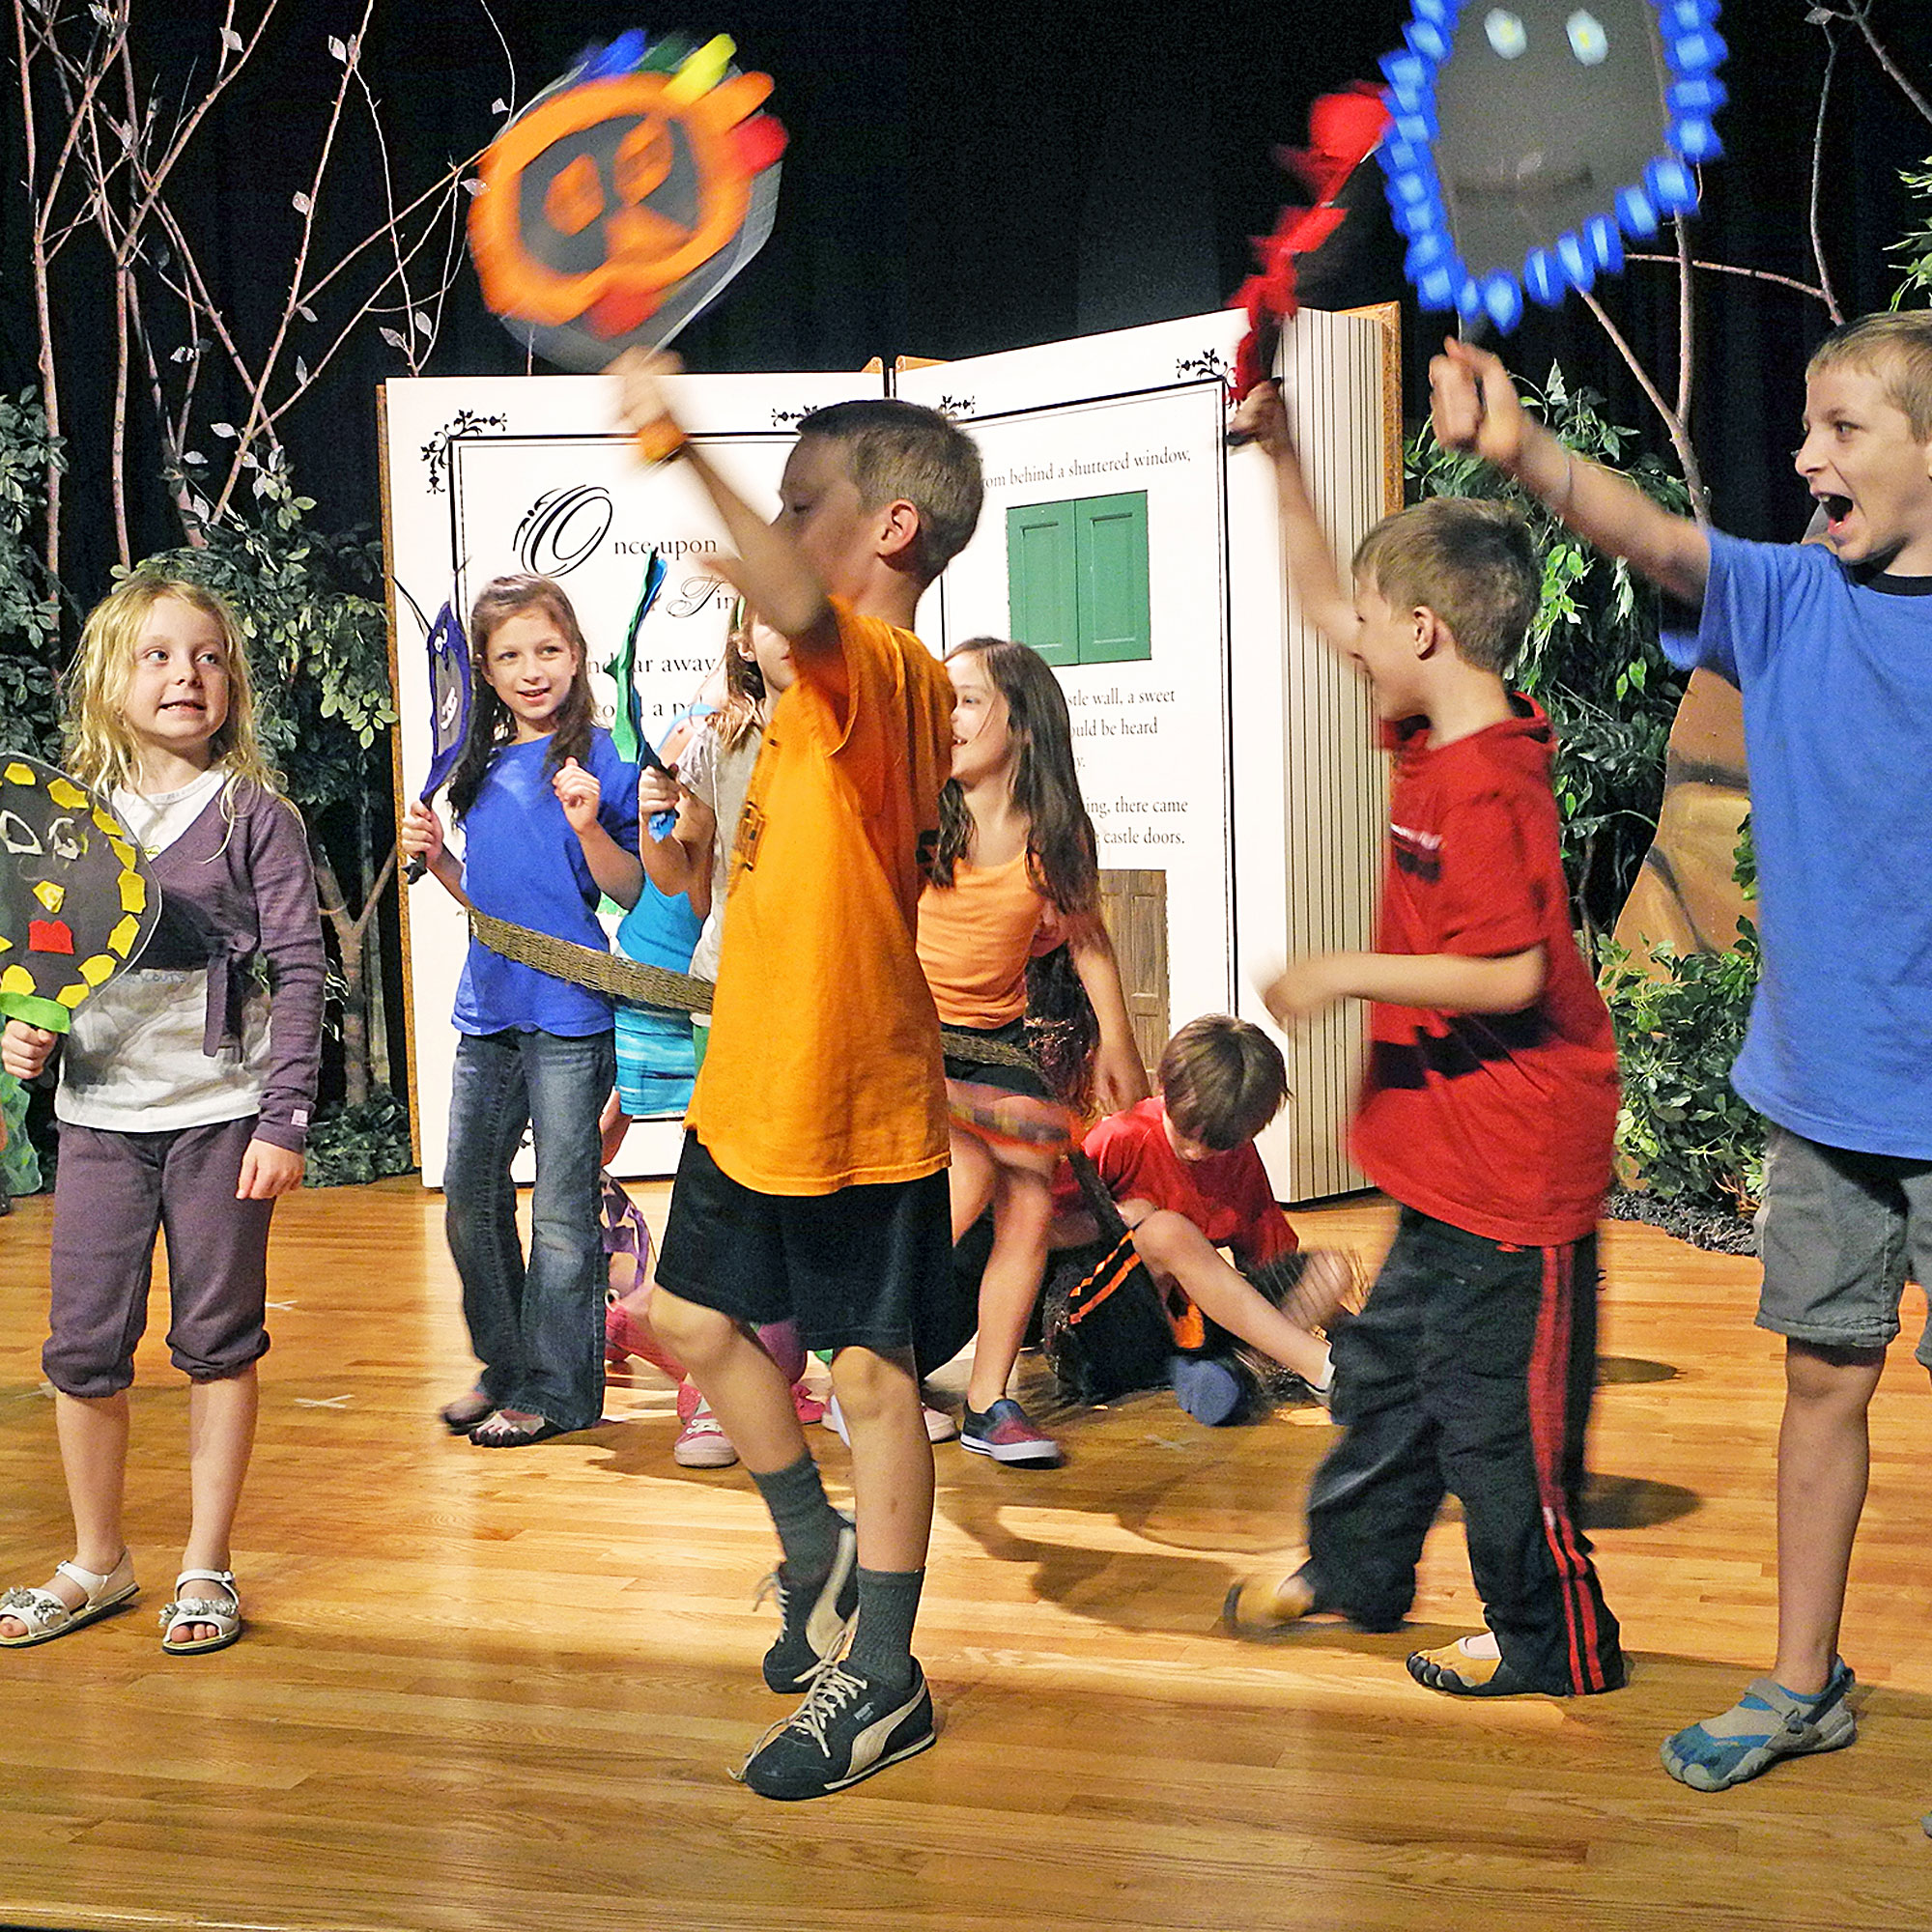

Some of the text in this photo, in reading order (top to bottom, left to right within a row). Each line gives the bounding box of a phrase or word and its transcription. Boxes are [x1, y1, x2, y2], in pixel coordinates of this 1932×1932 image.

[1010, 463, 1054, 484] behind
[1058, 468, 1065, 478] a
[1068, 451, 1129, 477] shuttered
[1134, 446, 1191, 467] window,
[660, 539, 718, 560] upon
[633, 660, 654, 673] ar
[1127, 693, 1135, 704] a
[1139, 691, 1175, 703] sweet
[1101, 718, 1117, 736] be
[1121, 716, 1158, 735] heard
[1115, 795, 1150, 813] there
[1152, 801, 1189, 813] came
[1103, 826, 1140, 844] castle
[1143, 826, 1185, 844] doors.
